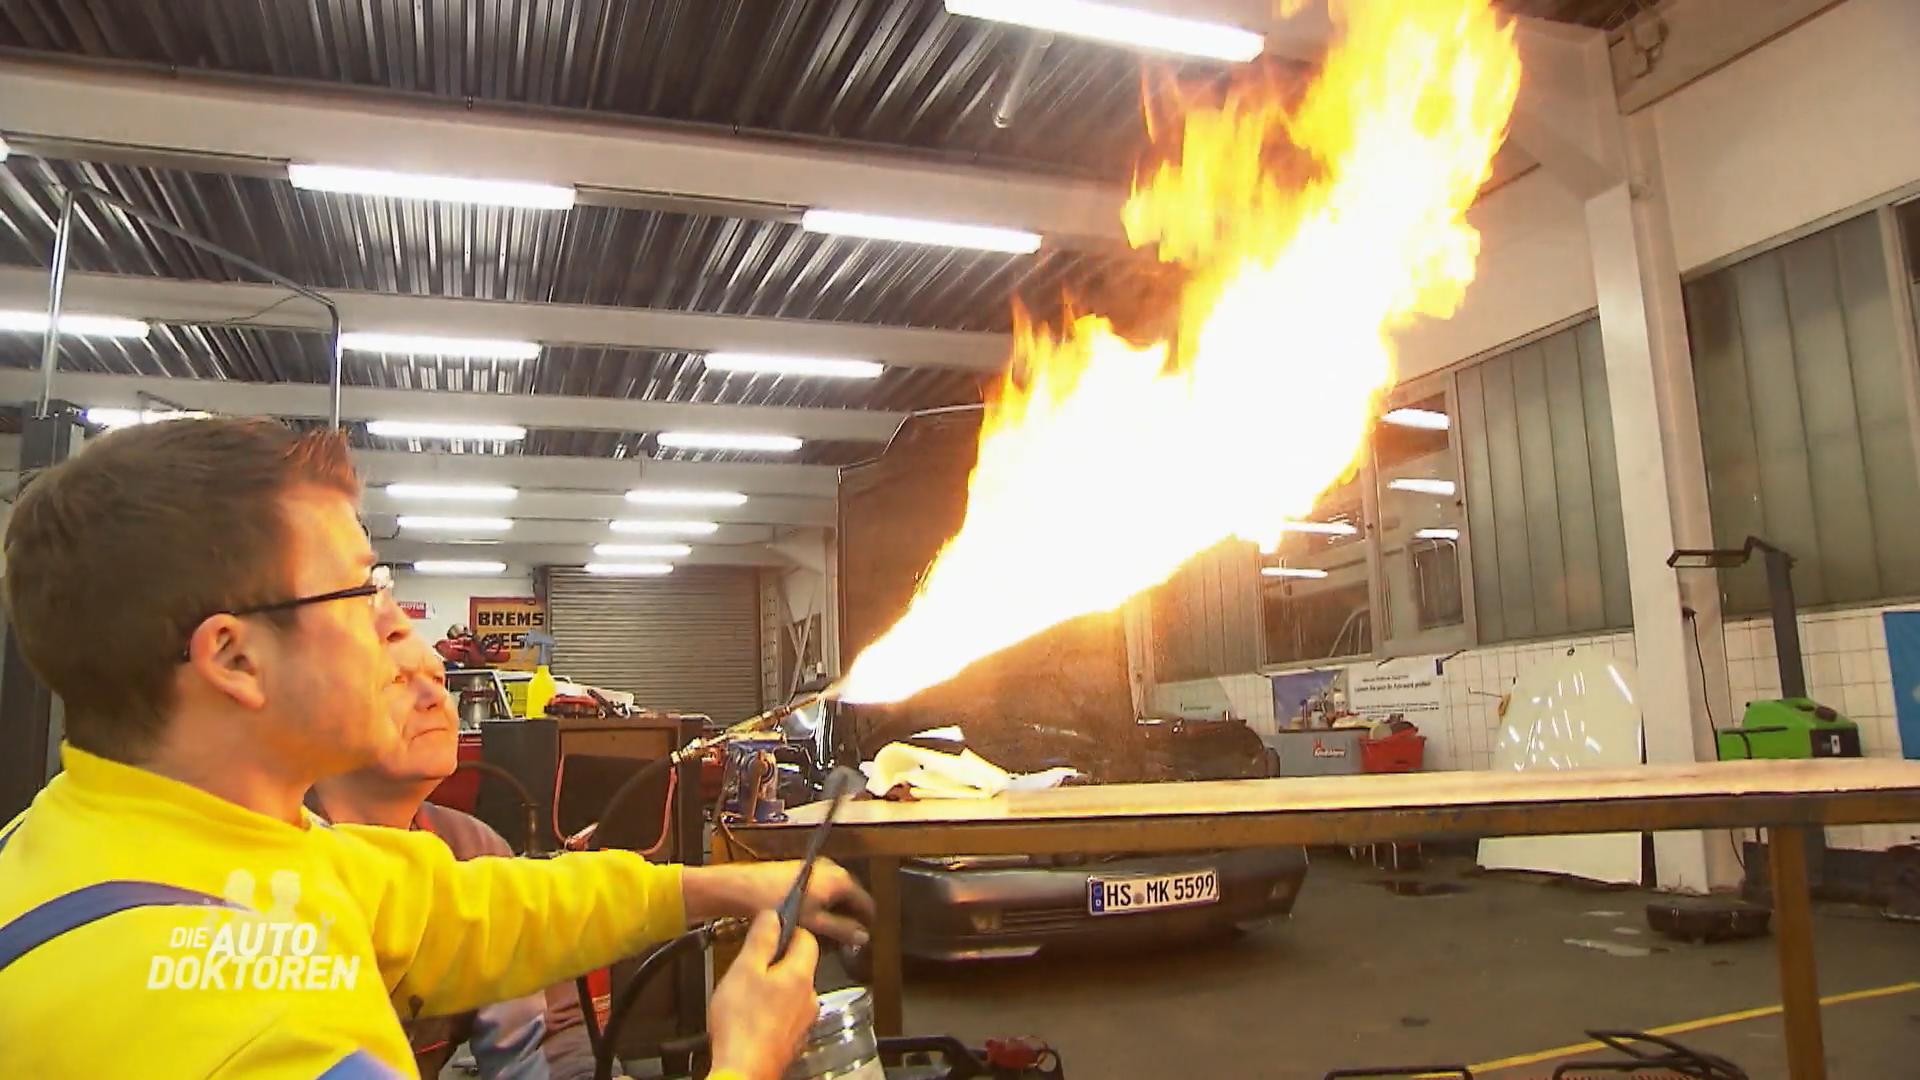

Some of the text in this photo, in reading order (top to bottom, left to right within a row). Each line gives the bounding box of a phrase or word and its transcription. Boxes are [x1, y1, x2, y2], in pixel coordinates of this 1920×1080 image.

[478, 611, 544, 626] BREMS
[1106, 874, 1214, 906] HS MK 5599
